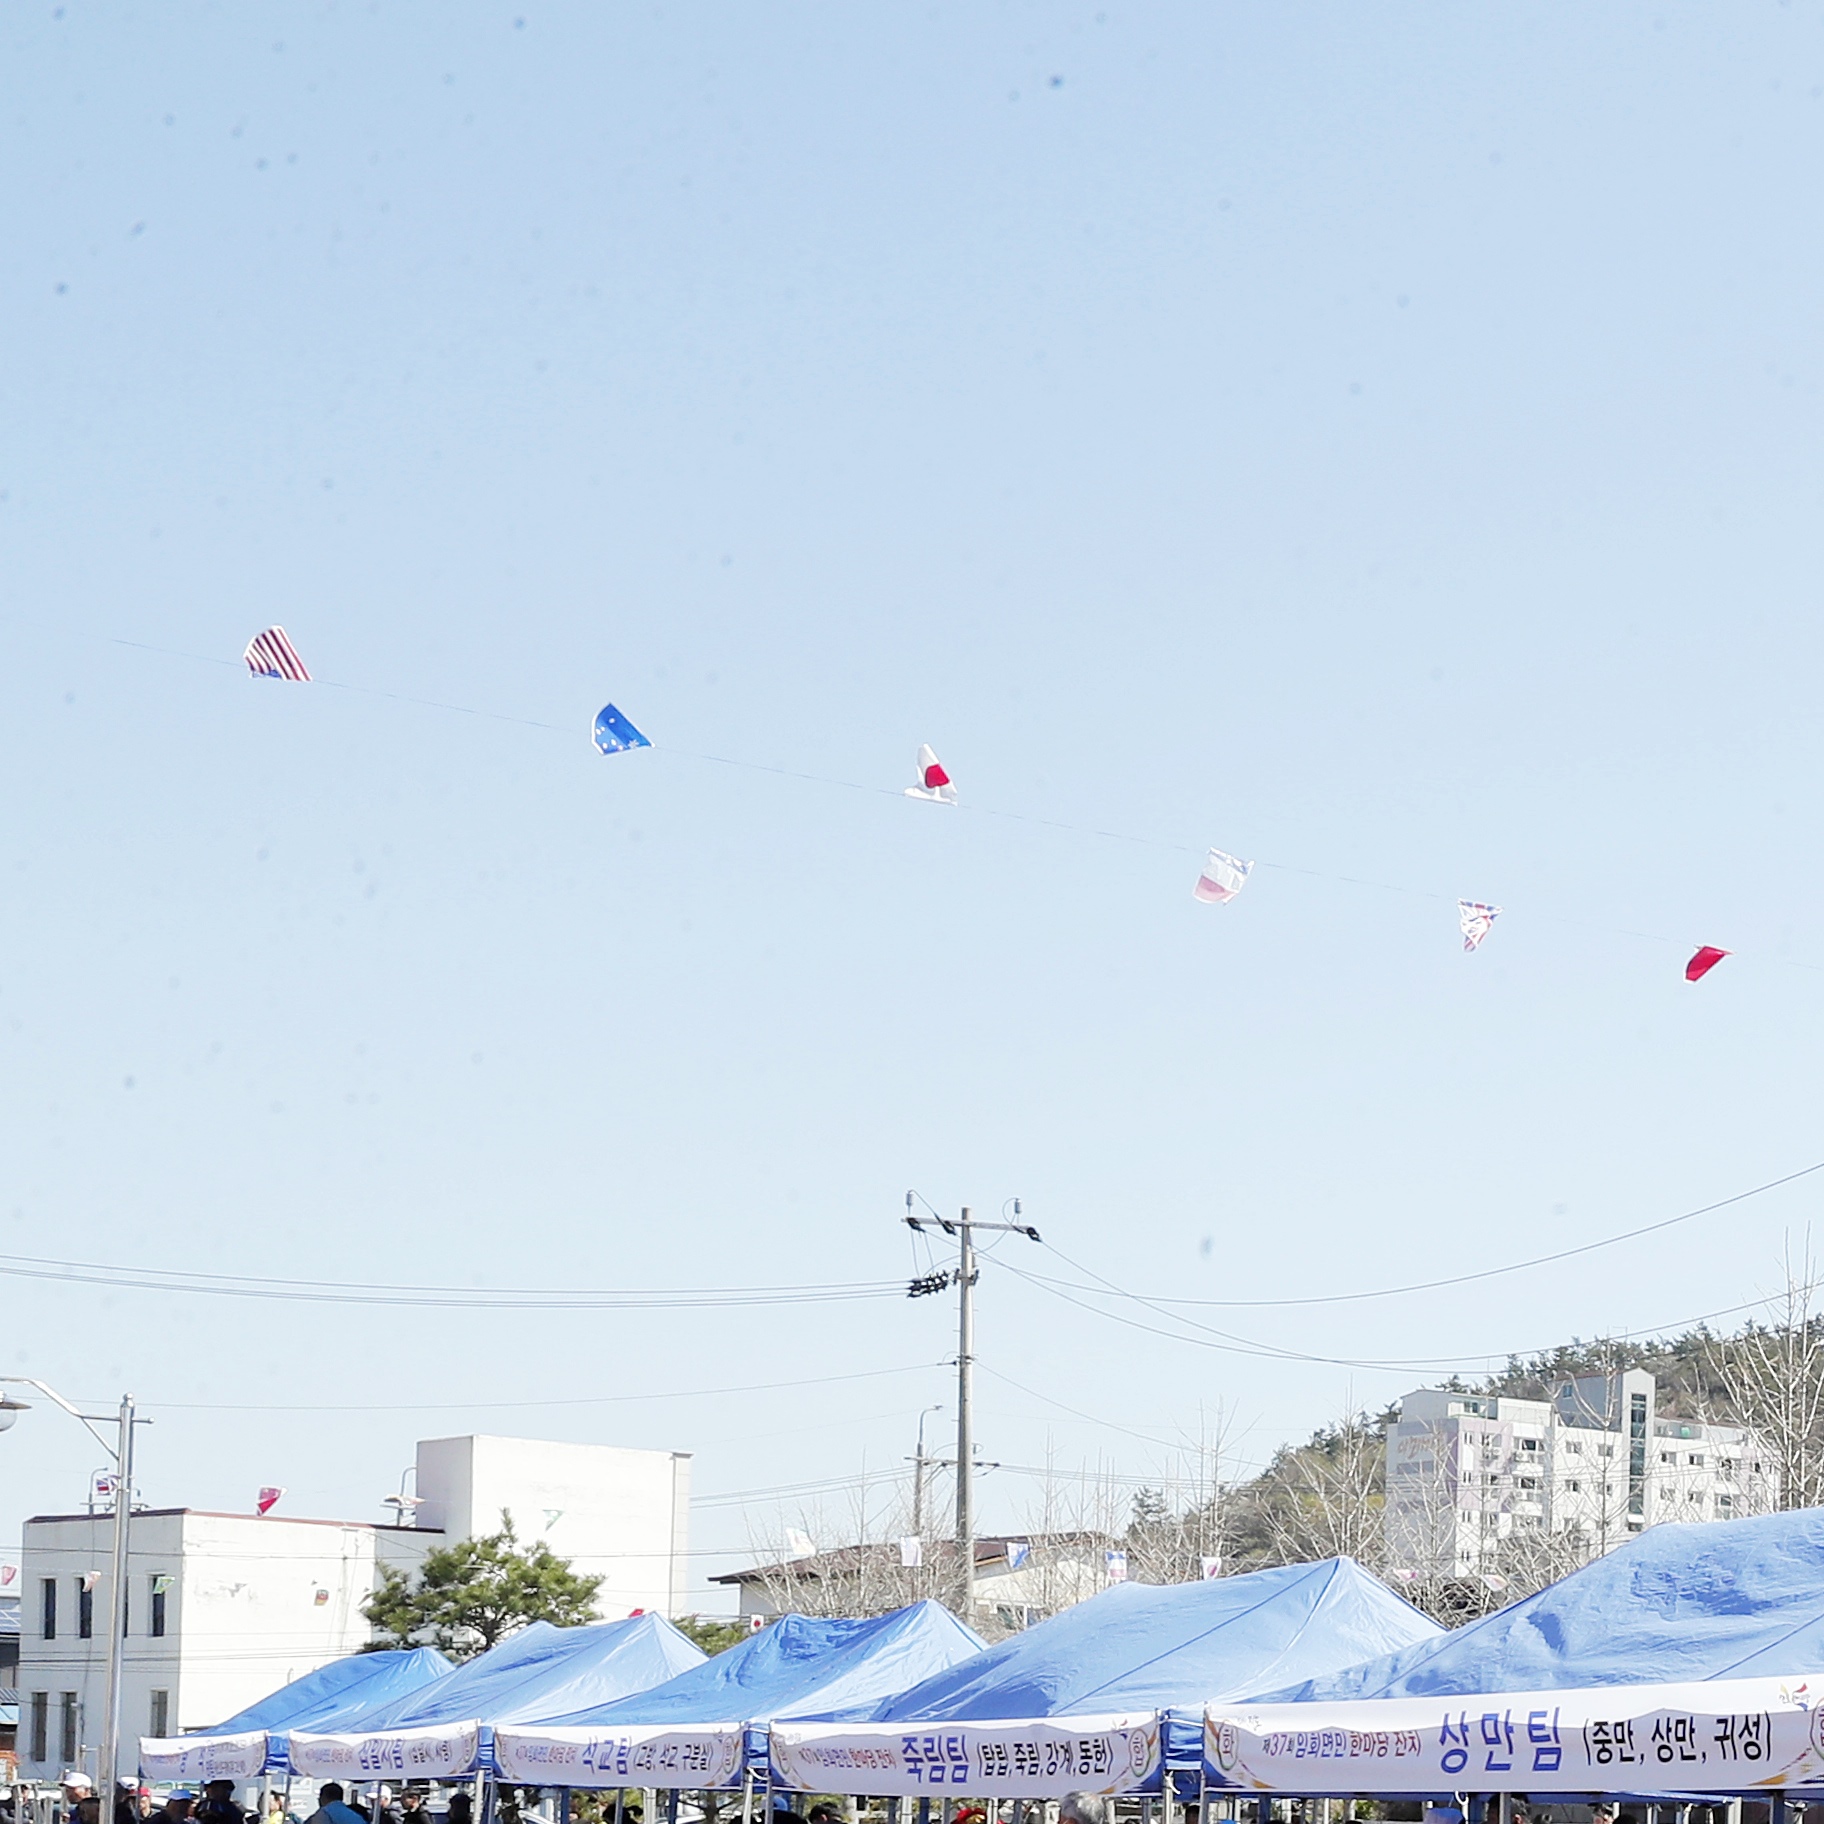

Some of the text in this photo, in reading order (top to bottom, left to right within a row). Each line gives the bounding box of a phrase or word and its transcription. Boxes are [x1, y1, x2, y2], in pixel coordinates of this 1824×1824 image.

[582, 1735, 632, 1775] 석교팀
[901, 1734, 971, 1784] 죽림팀
[1295, 1733, 1348, 1759] 임회면민
[1349, 1731, 1391, 1759] 한마당
[1394, 1729, 1423, 1758] 잔치
[1438, 1706, 1772, 1774] 상만팀 (중만, 상만, 귀성)
